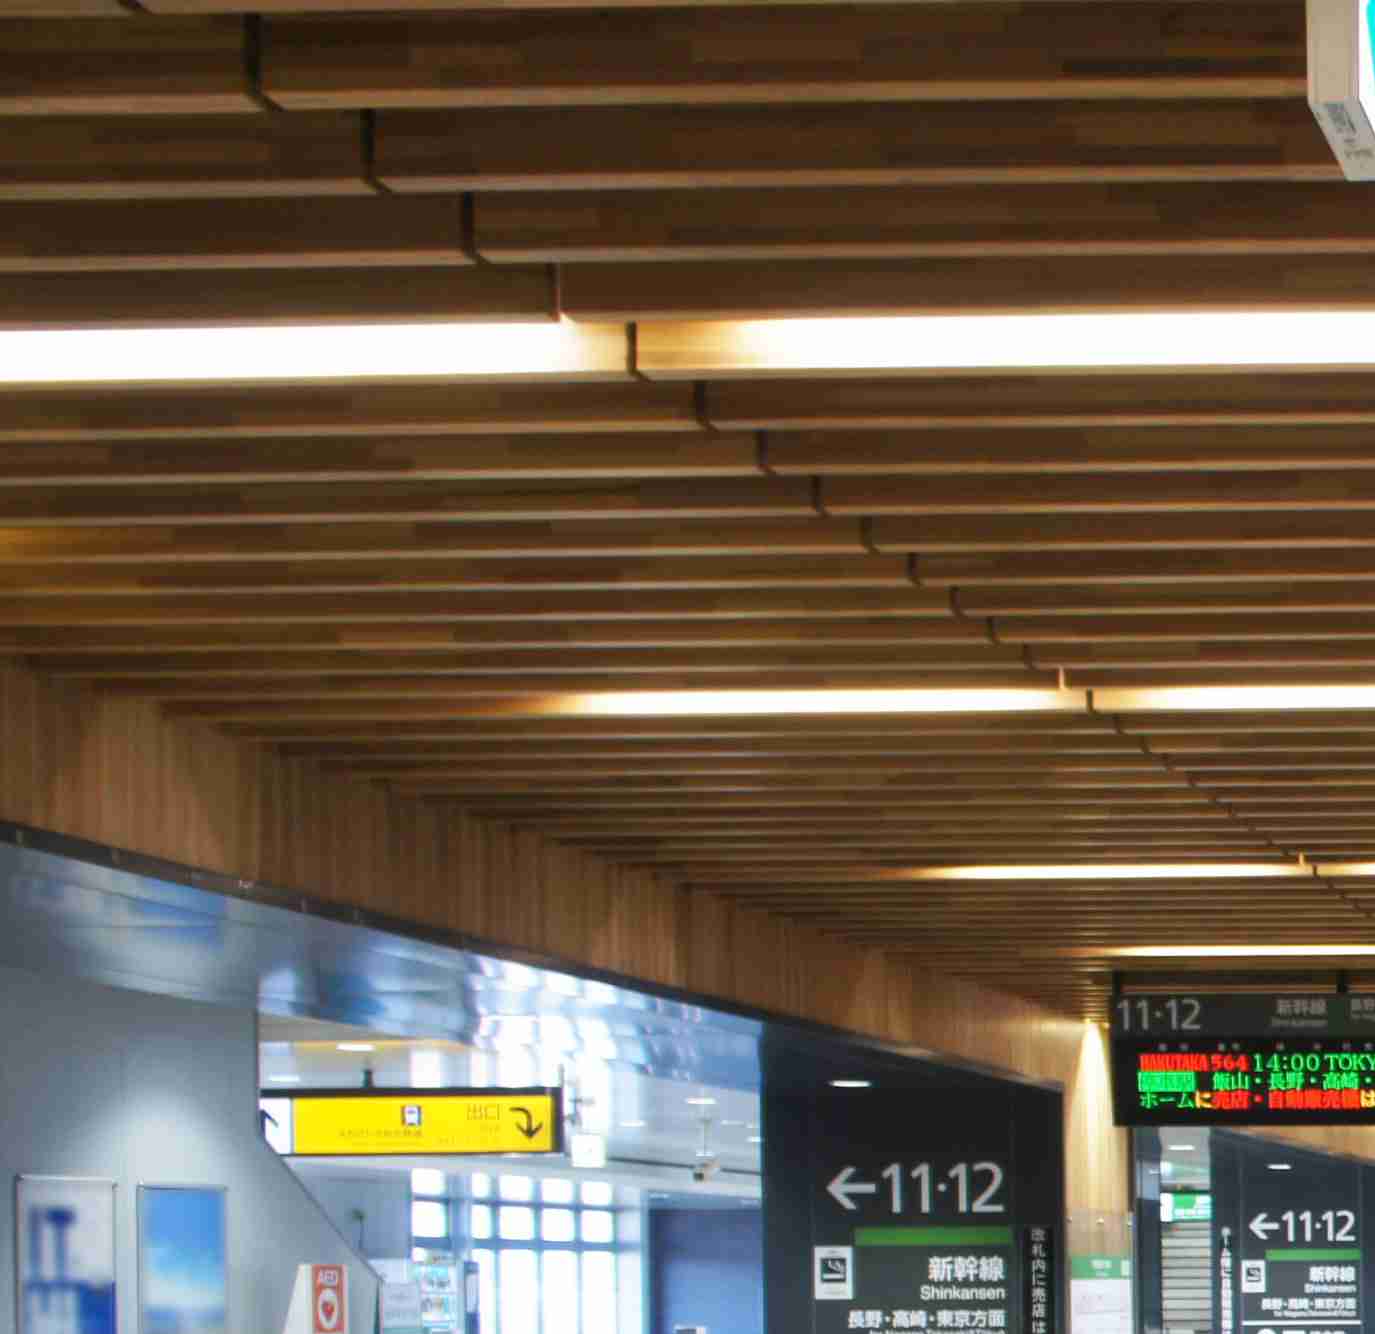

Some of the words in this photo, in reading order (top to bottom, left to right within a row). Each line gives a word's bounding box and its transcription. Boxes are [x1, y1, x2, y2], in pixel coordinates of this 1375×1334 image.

[1253, 1054, 1320, 1072] 14:00
[928, 1256, 1005, 1282] 新幹線
[920, 1285, 1006, 1300] Shinkansen
